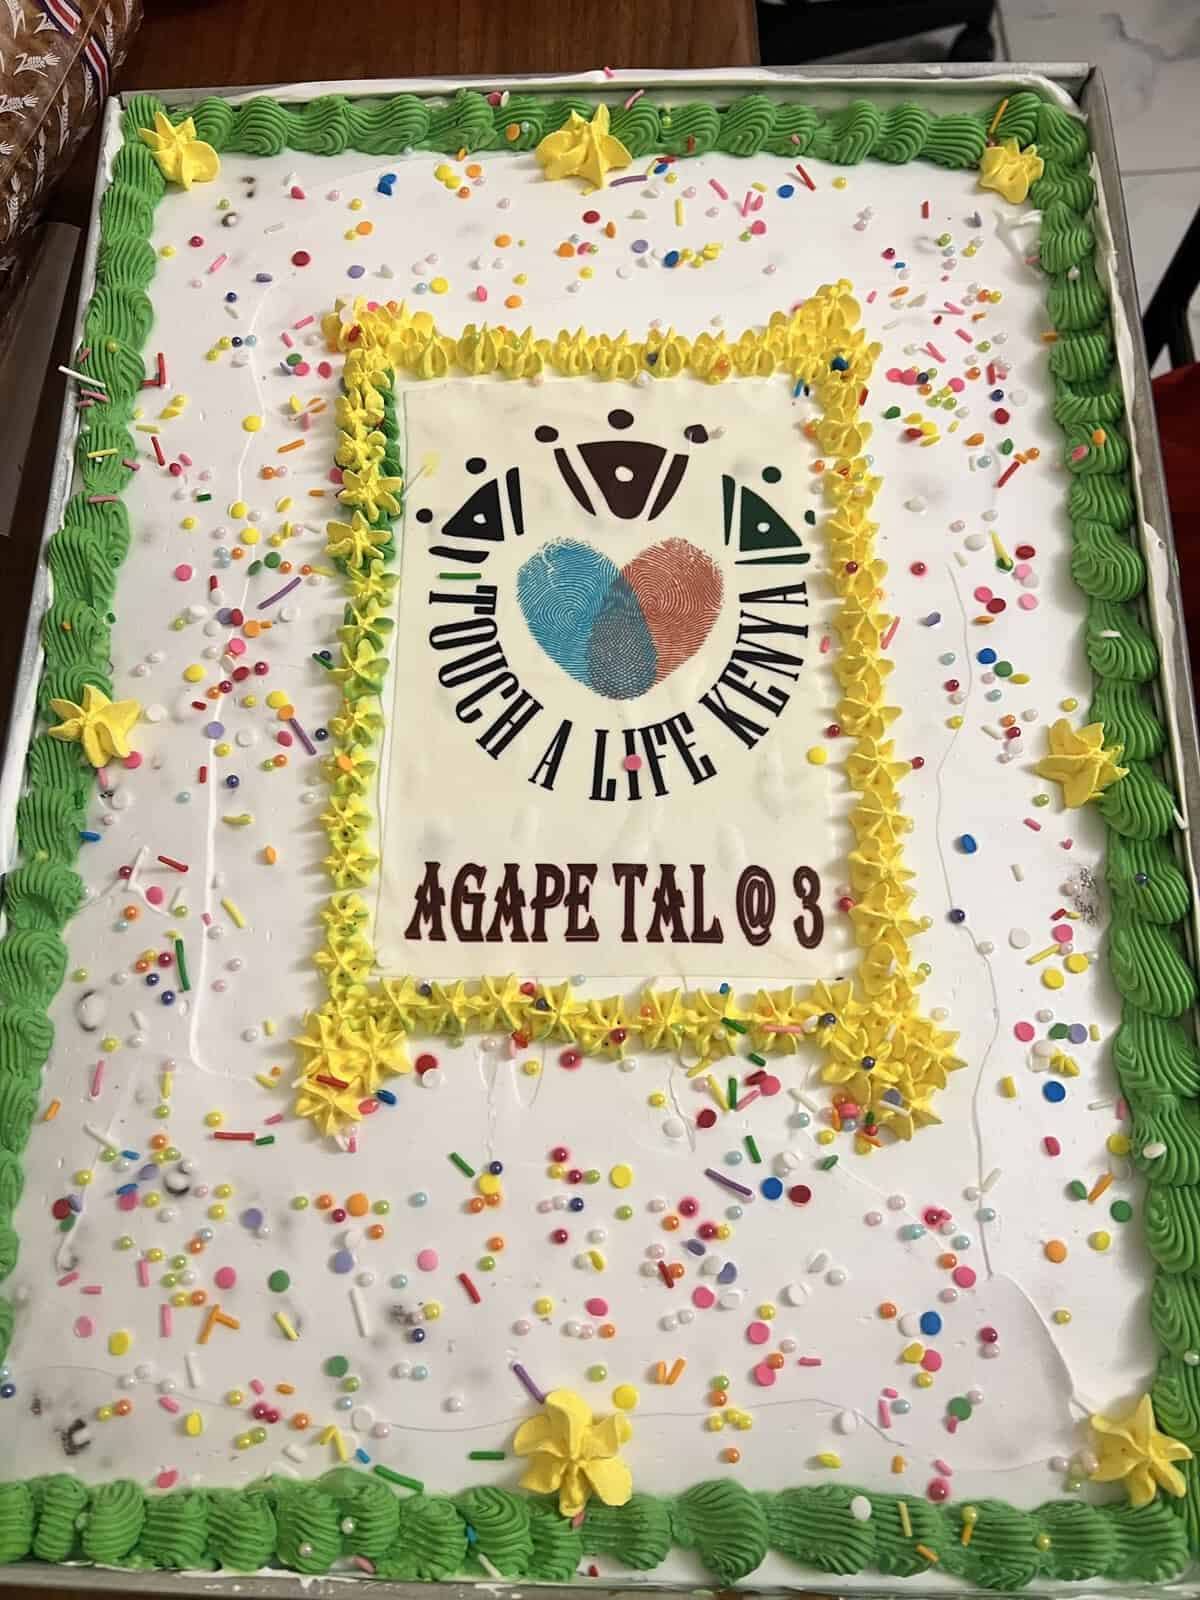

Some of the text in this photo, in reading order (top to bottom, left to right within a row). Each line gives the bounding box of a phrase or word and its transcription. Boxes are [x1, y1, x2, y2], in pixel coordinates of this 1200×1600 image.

[429, 581, 809, 802] TOUCH A LIFE KENYA
[404, 861, 825, 950] AGAPE TAL @ 3
